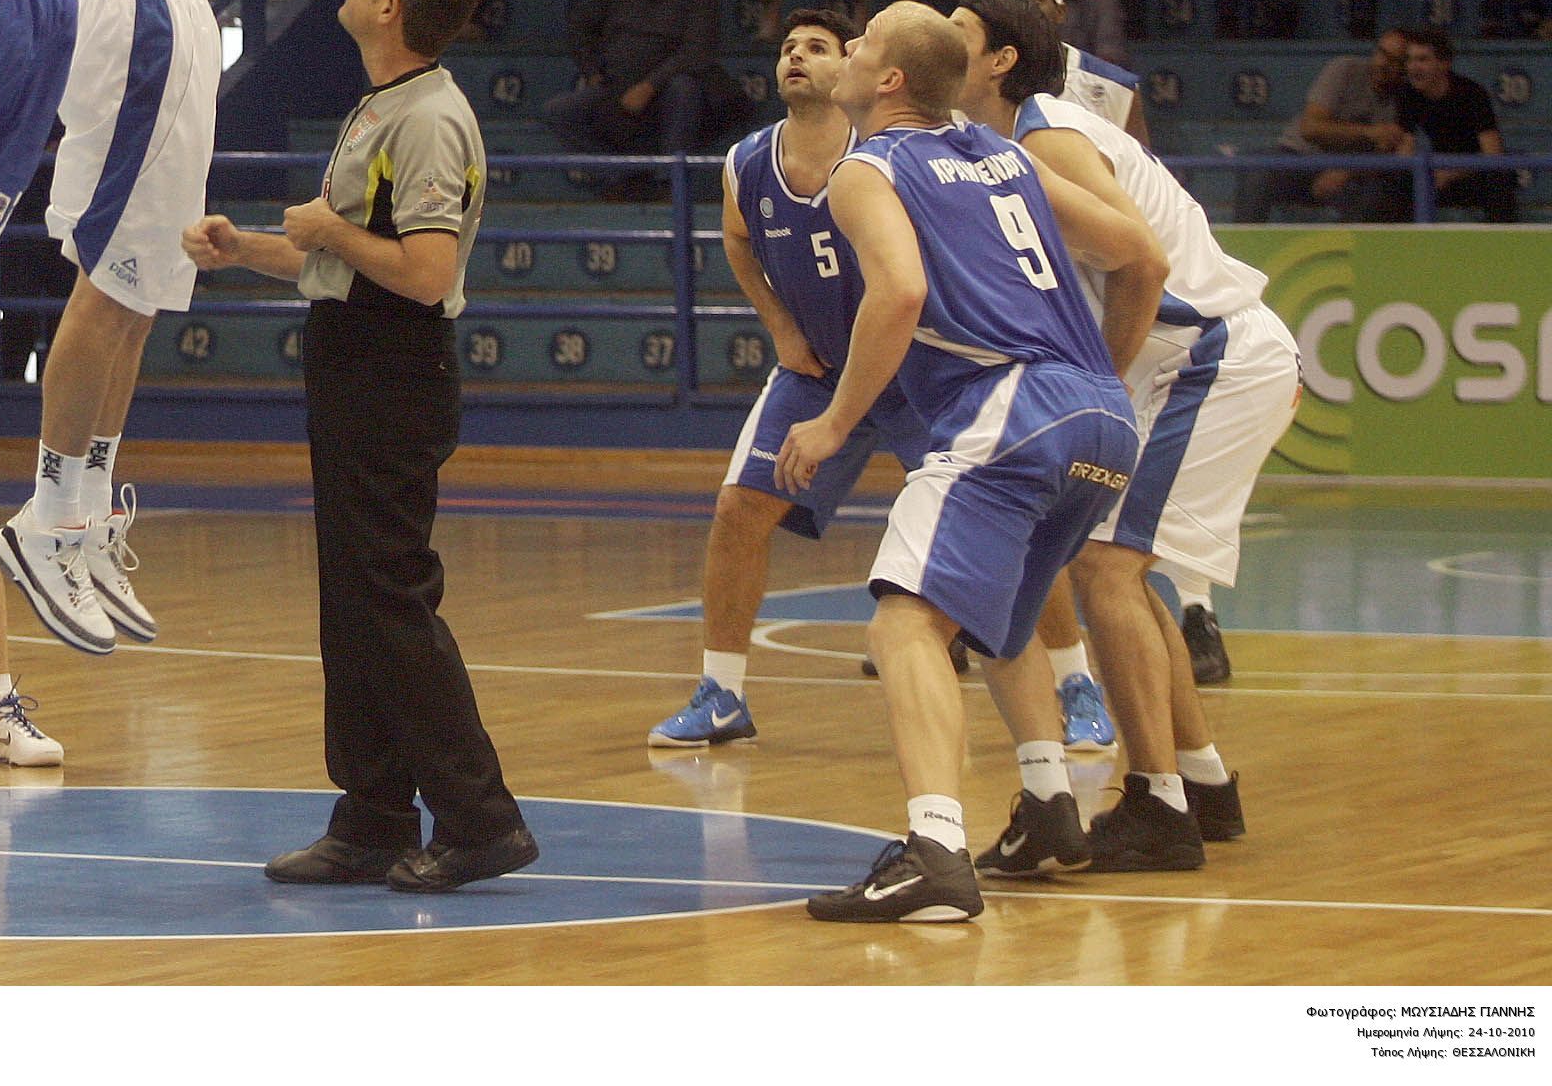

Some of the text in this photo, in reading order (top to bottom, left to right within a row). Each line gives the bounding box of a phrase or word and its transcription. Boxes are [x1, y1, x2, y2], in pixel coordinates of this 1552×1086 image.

[493, 76, 520, 103] 42
[1237, 74, 1266, 104] 33
[501, 242, 533, 271] 40
[586, 242, 618, 271] 39
[810, 230, 840, 279] 5
[989, 194, 1059, 291] 9
[180, 326, 211, 358] 42
[469, 333, 500, 366] 39
[554, 332, 586, 366] 38
[643, 335, 675, 366] 37
[41, 448, 64, 486] PEAK
[85, 439, 111, 472] PEAK
